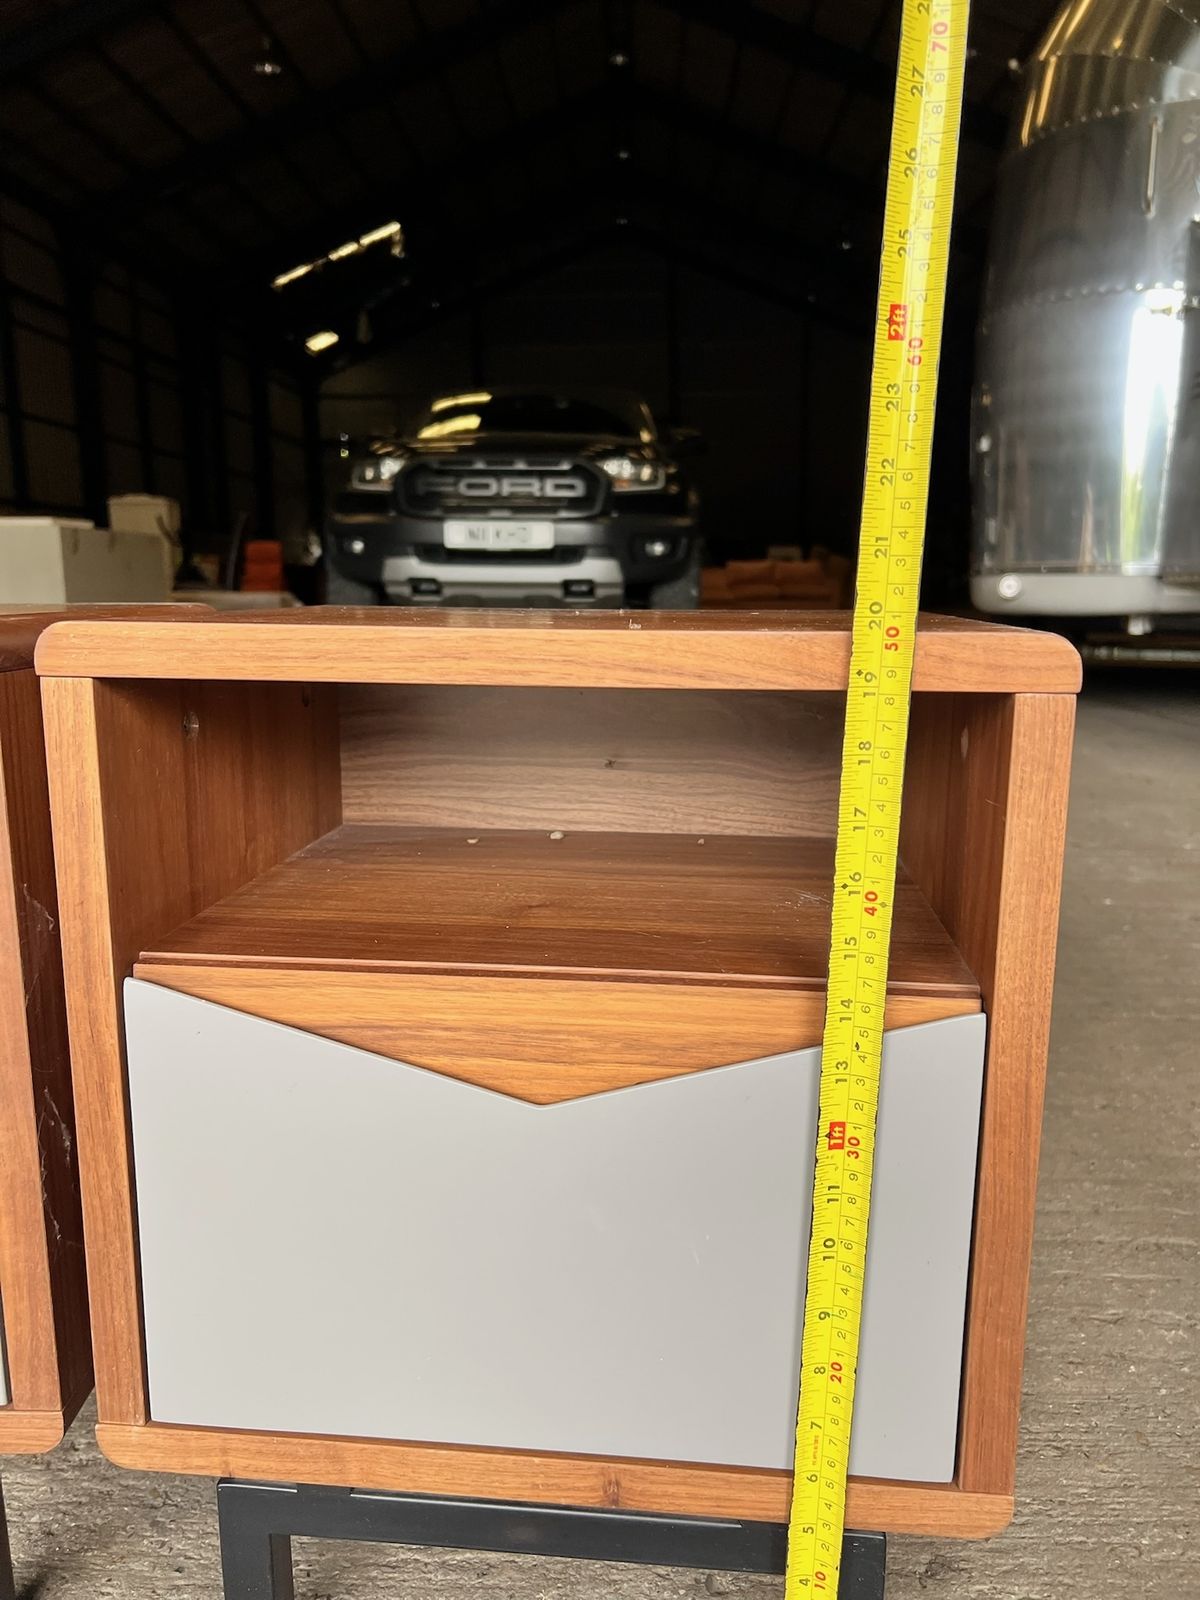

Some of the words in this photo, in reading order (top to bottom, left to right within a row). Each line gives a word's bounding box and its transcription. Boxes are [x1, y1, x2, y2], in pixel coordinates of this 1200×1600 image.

[917, 0, 930, 15] 2
[910, 64, 924, 97] 27
[903, 147, 918, 178] 26
[897, 229, 912, 258] 25
[890, 309, 906, 337] 2ft
[885, 383, 901, 412] 23
[907, 412, 919, 423] 8
[904, 442, 916, 452] 7
[879, 458, 895, 487] 22
[902, 472, 914, 482] 6
[416, 476, 586, 498] FORD
[900, 501, 911, 510] 5
[898, 530, 909, 540] 4
[874, 535, 889, 559] 21
[895, 558, 907, 567] 3
[893, 586, 905, 596] 2
[868, 601, 883, 630] 20
[885, 626, 900, 652] 50
[886, 669, 897, 679] 9
[863, 671, 877, 698] 19
[884, 697, 895, 706] 8
[882, 723, 893, 732] 7
[857, 740, 872, 766] 18
[880, 750, 890, 759] 6
[878, 776, 888, 785] 5
[876, 803, 887, 812] 4
[852, 806, 866, 832] 17
[874, 829, 884, 838] 3
[872, 854, 882, 864] 2
[848, 871, 862, 896] 16
[864, 891, 878, 916] 40
[866, 931, 877, 940] 9
[843, 936, 857, 960] 15
[864, 956, 875, 964] 8
[863, 980, 873, 989] 7
[839, 998, 854, 1023] 14
[860, 1005, 871, 1014] 6
[859, 1029, 869, 1038] 5
[857, 1054, 868, 1063] 4
[835, 1060, 849, 1085] 13
[856, 1078, 866, 1086] 3
[854, 1102, 864, 1111] 2
[830, 1126, 844, 1145] 1ft
[847, 1136, 861, 1160] 30
[849, 1173, 859, 1181] 9
[826, 1184, 840, 1204] 11
[847, 1196, 857, 1205] 8
[845, 1218, 855, 1227] 7
[822, 1238, 836, 1262] 10
[843, 1242, 853, 1251] 6
[841, 1264, 852, 1273] 5
[840, 1287, 850, 1296] 4
[818, 1311, 832, 1321] 9
[838, 1309, 848, 1318] 3
[837, 1331, 847, 1340] 2
[813, 1366, 826, 1375] 8
[830, 1362, 843, 1384] 20
[831, 1396, 841, 1404] 9
[810, 1421, 822, 1430] 7
[830, 1418, 840, 1426] 8
[827, 1460, 836, 1468] 6
[806, 1474, 818, 1483] 6
[825, 1482, 835, 1490] 5
[821, 1543, 830, 1552] 2
[798, 1578, 811, 1586] 4
[814, 1571, 826, 1591] 10
